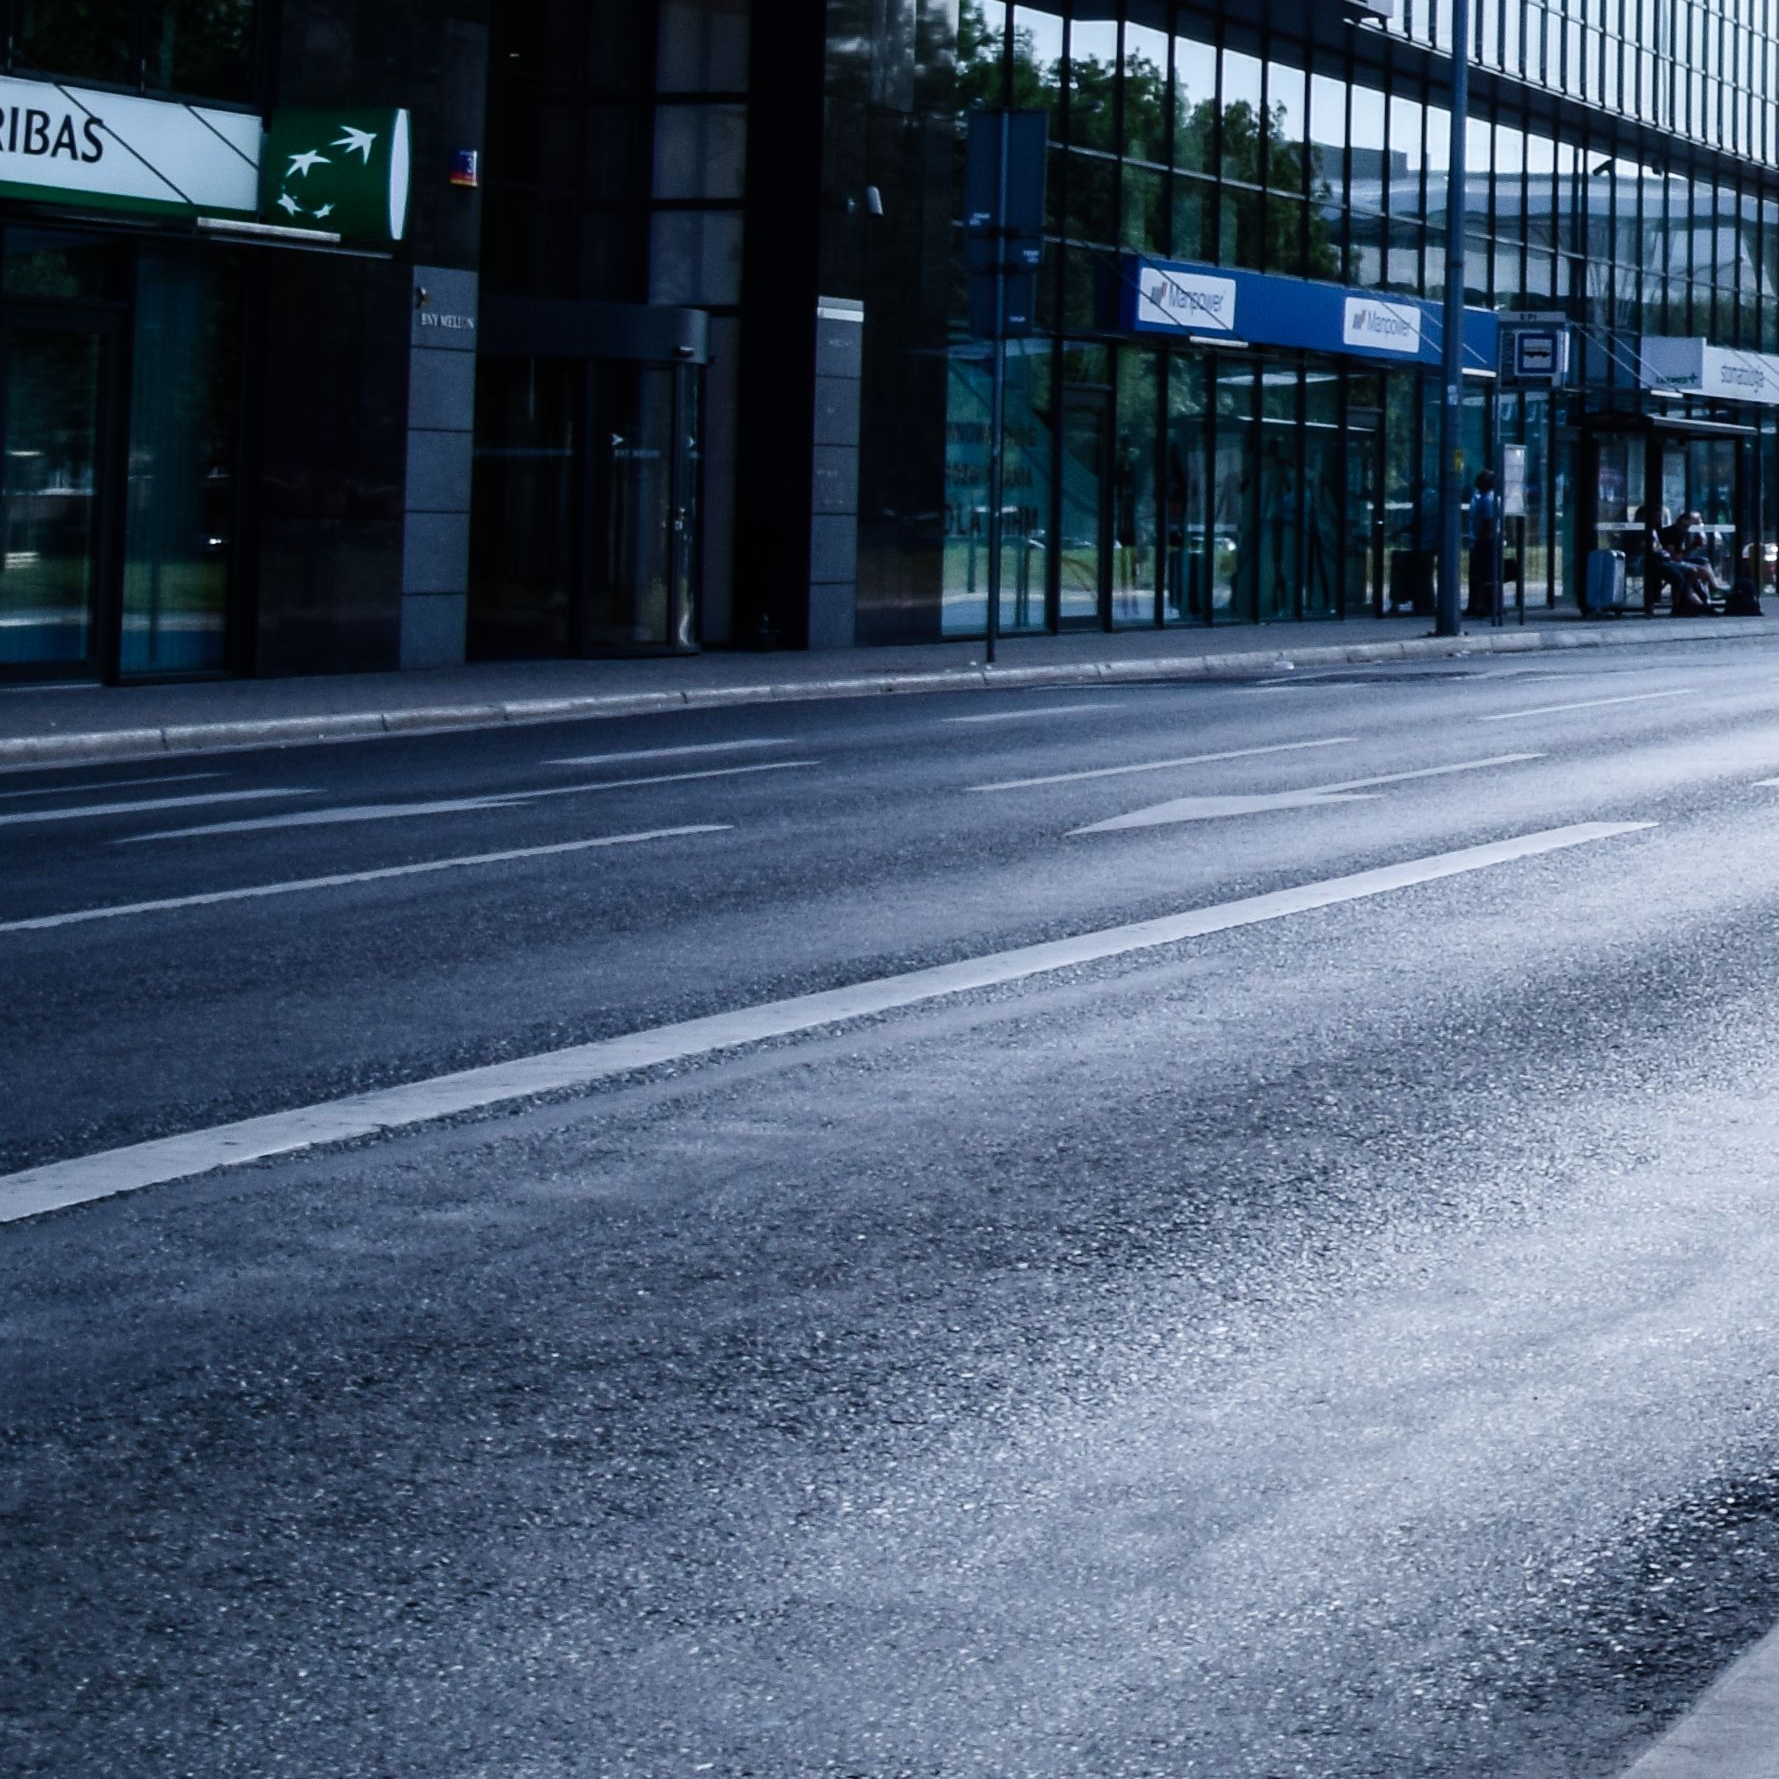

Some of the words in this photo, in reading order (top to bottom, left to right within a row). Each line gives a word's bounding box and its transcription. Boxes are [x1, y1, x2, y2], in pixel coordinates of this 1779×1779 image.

[0, 106, 104, 164] IBAS
[1169, 283, 1223, 316] Manpower
[1367, 310, 1410, 339] Manpower
